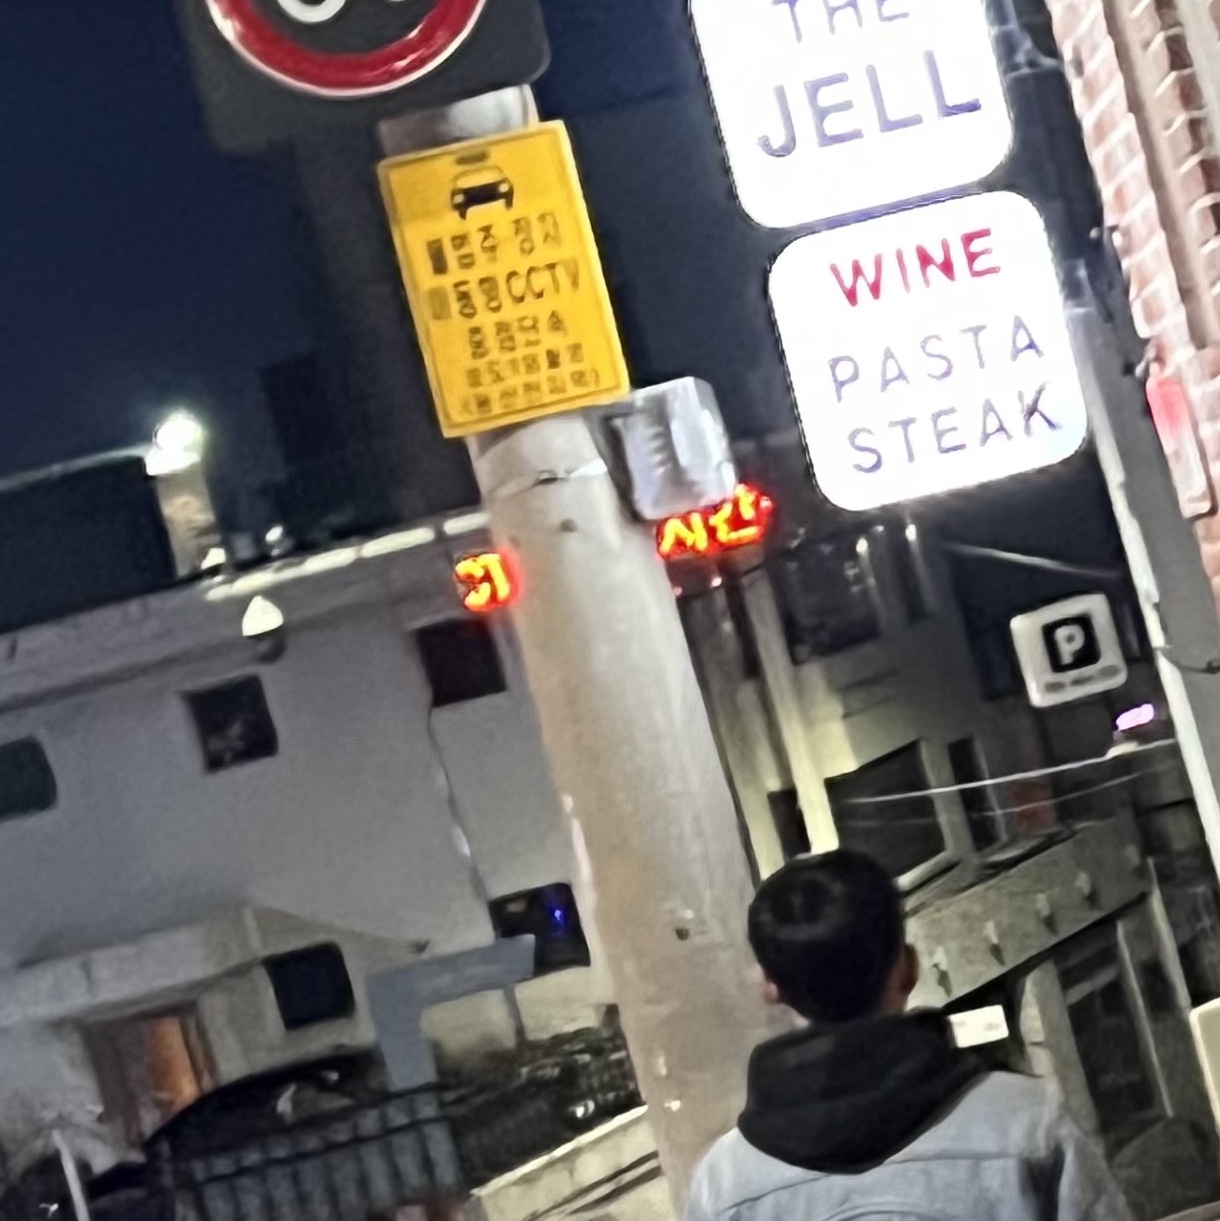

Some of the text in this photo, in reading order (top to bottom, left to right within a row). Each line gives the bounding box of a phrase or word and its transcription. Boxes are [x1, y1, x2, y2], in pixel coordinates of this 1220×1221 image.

[757, 50, 982, 157] JELL
[830, 228, 1001, 306] WINE
[828, 315, 1044, 403] PASTA
[847, 382, 1063, 474] STEAK
[1054, 624, 1086, 666] P
